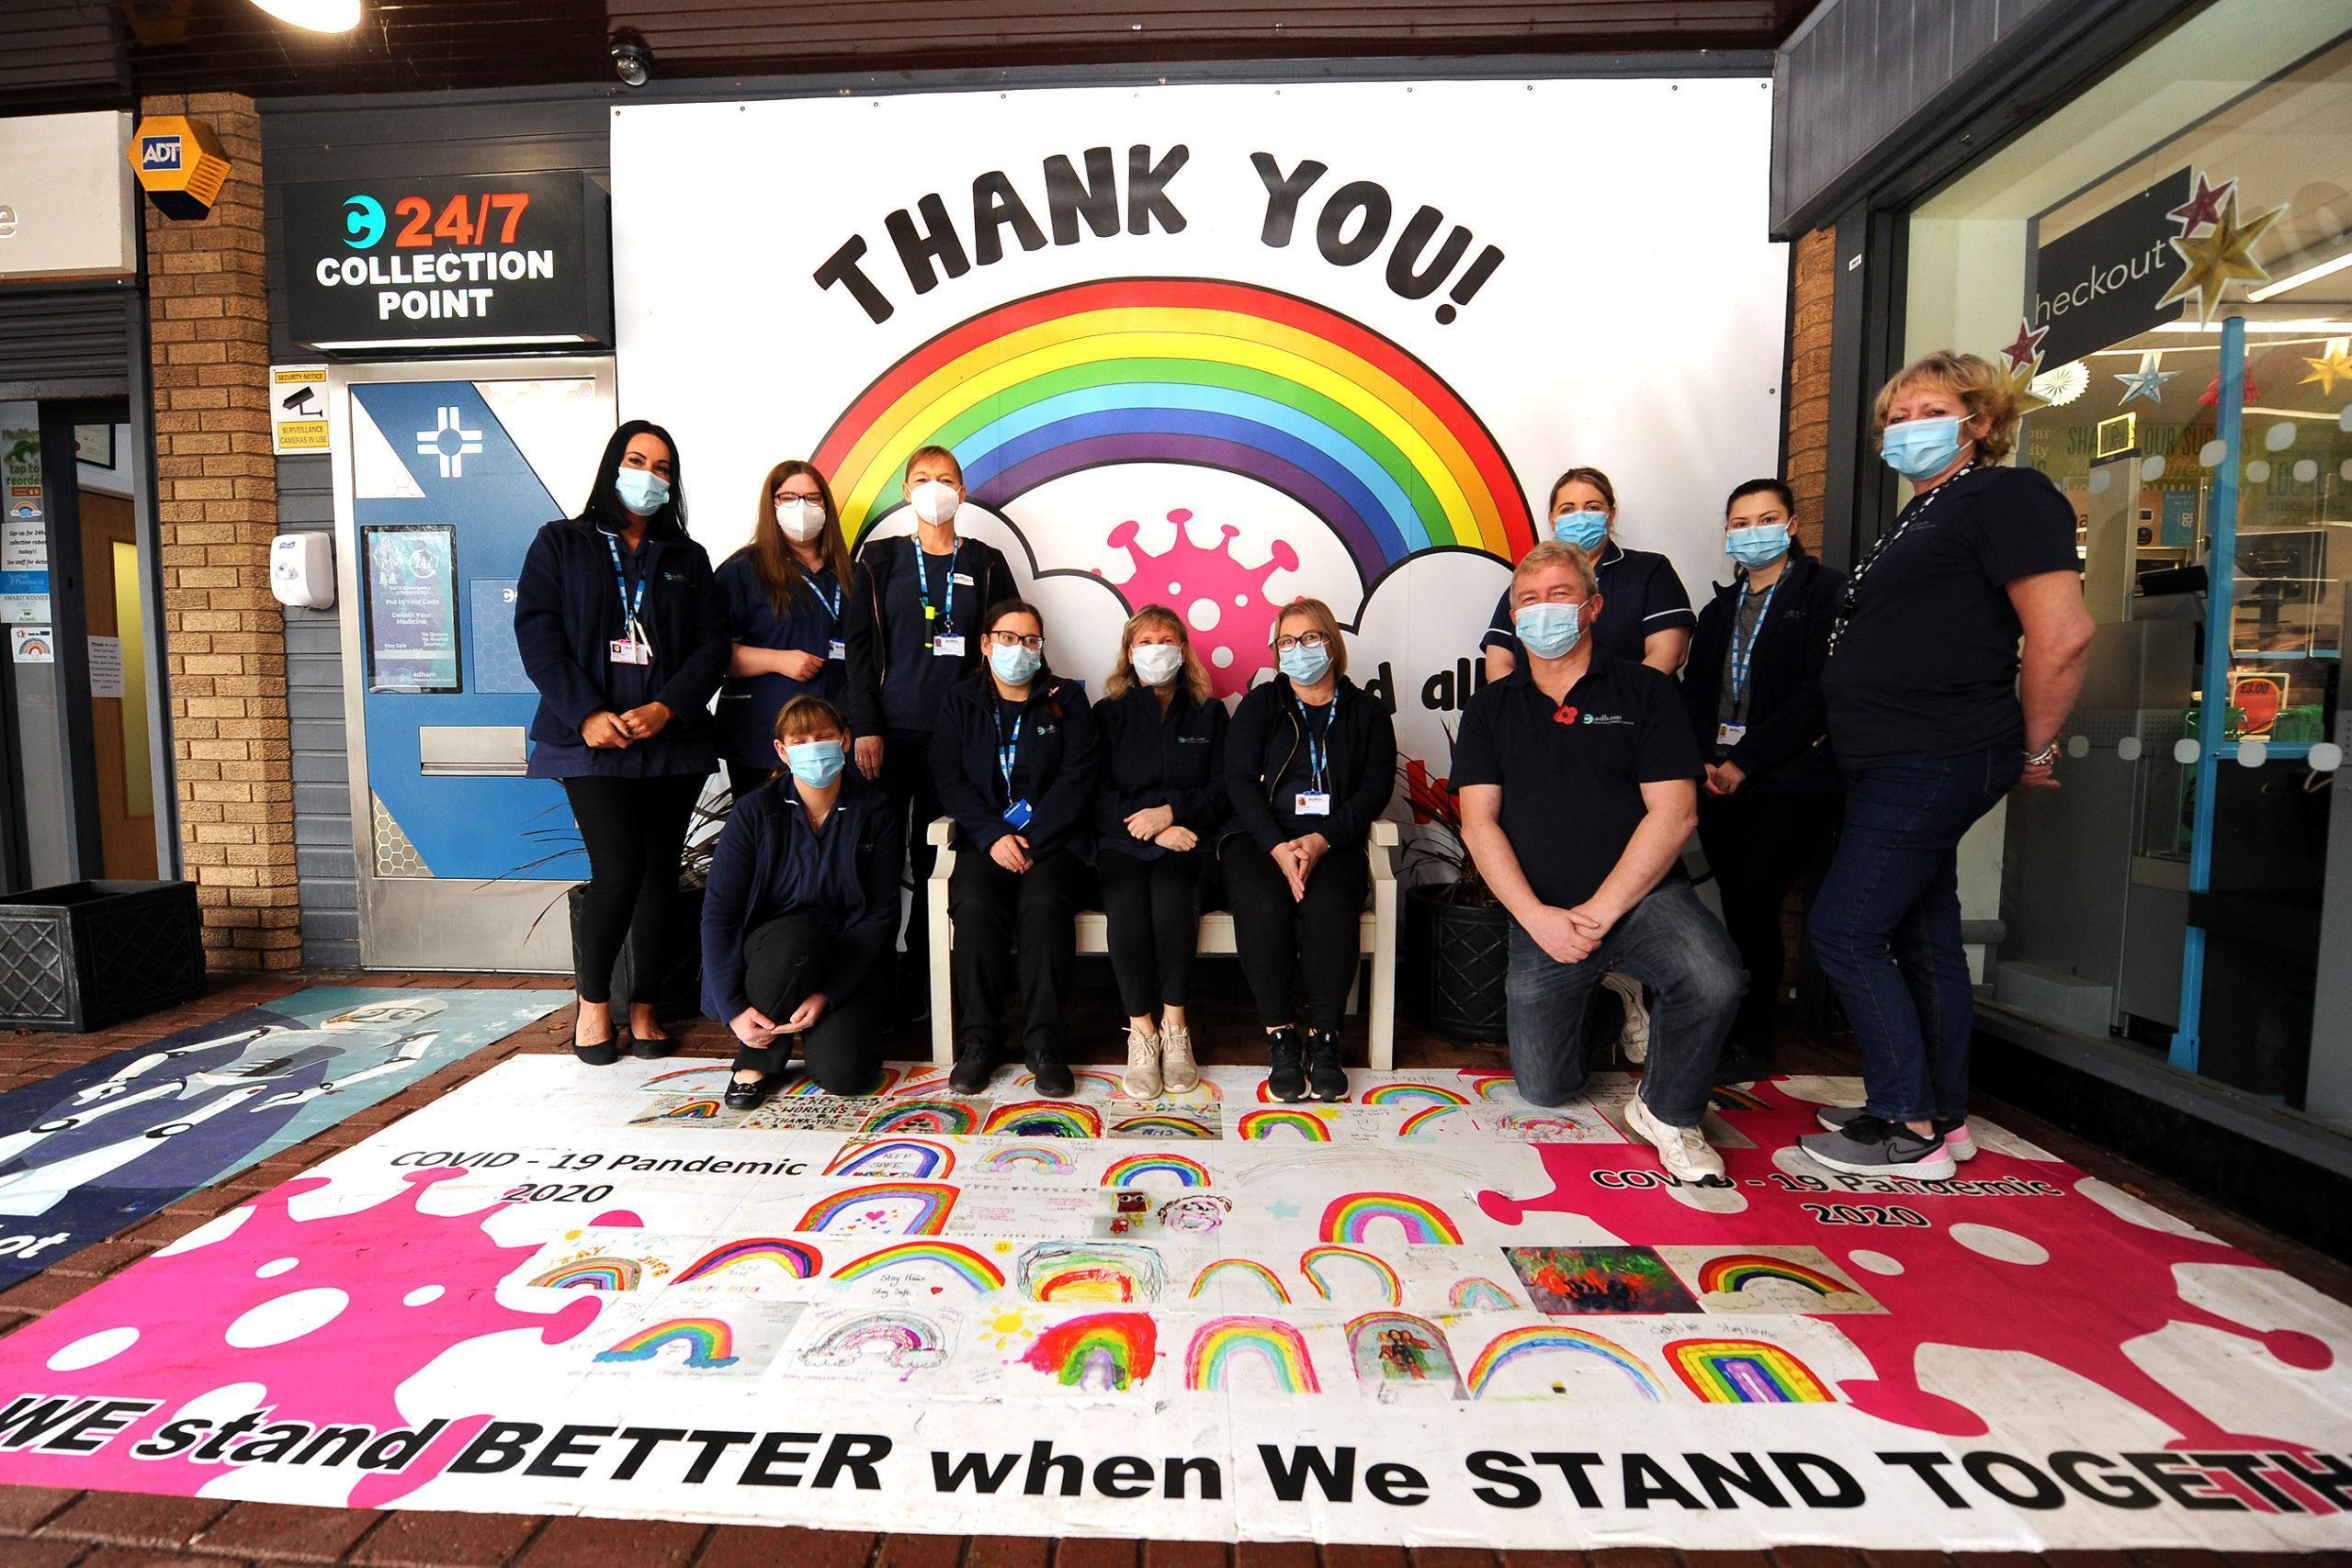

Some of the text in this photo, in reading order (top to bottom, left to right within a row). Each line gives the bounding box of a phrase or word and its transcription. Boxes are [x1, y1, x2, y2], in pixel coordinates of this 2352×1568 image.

[142, 142, 180, 163] ADT
[395, 192, 530, 248] 24/7
[813, 143, 1505, 325] THANK YOU!
[316, 249, 553, 287] COLLECTION
[379, 288, 493, 321] POINT
[774, 1117, 811, 1125] THANK
[781, 1106, 846, 1114] WORKERS
[1142, 1128, 1173, 1137] NHS
[390, 1151, 521, 1168] COVID
[547, 1153, 605, 1171] 19
[606, 1154, 808, 1177] Pandemic
[1590, 1169, 1737, 1190] COV
[1770, 1174, 1831, 1192] 19
[500, 1183, 615, 1203] 2020
[1800, 1202, 1931, 1228] 2020
[879, 1273, 900, 1287] Stay
[872, 1288, 889, 1296] Stay
[0, 1397, 157, 1450] WE
[135, 1408, 451, 1472] stand
[446, 1422, 892, 1492] BETTER
[929, 1440, 1223, 1501] when
[1256, 1444, 1431, 1508] We
[1464, 1449, 1868, 1511] STAND
